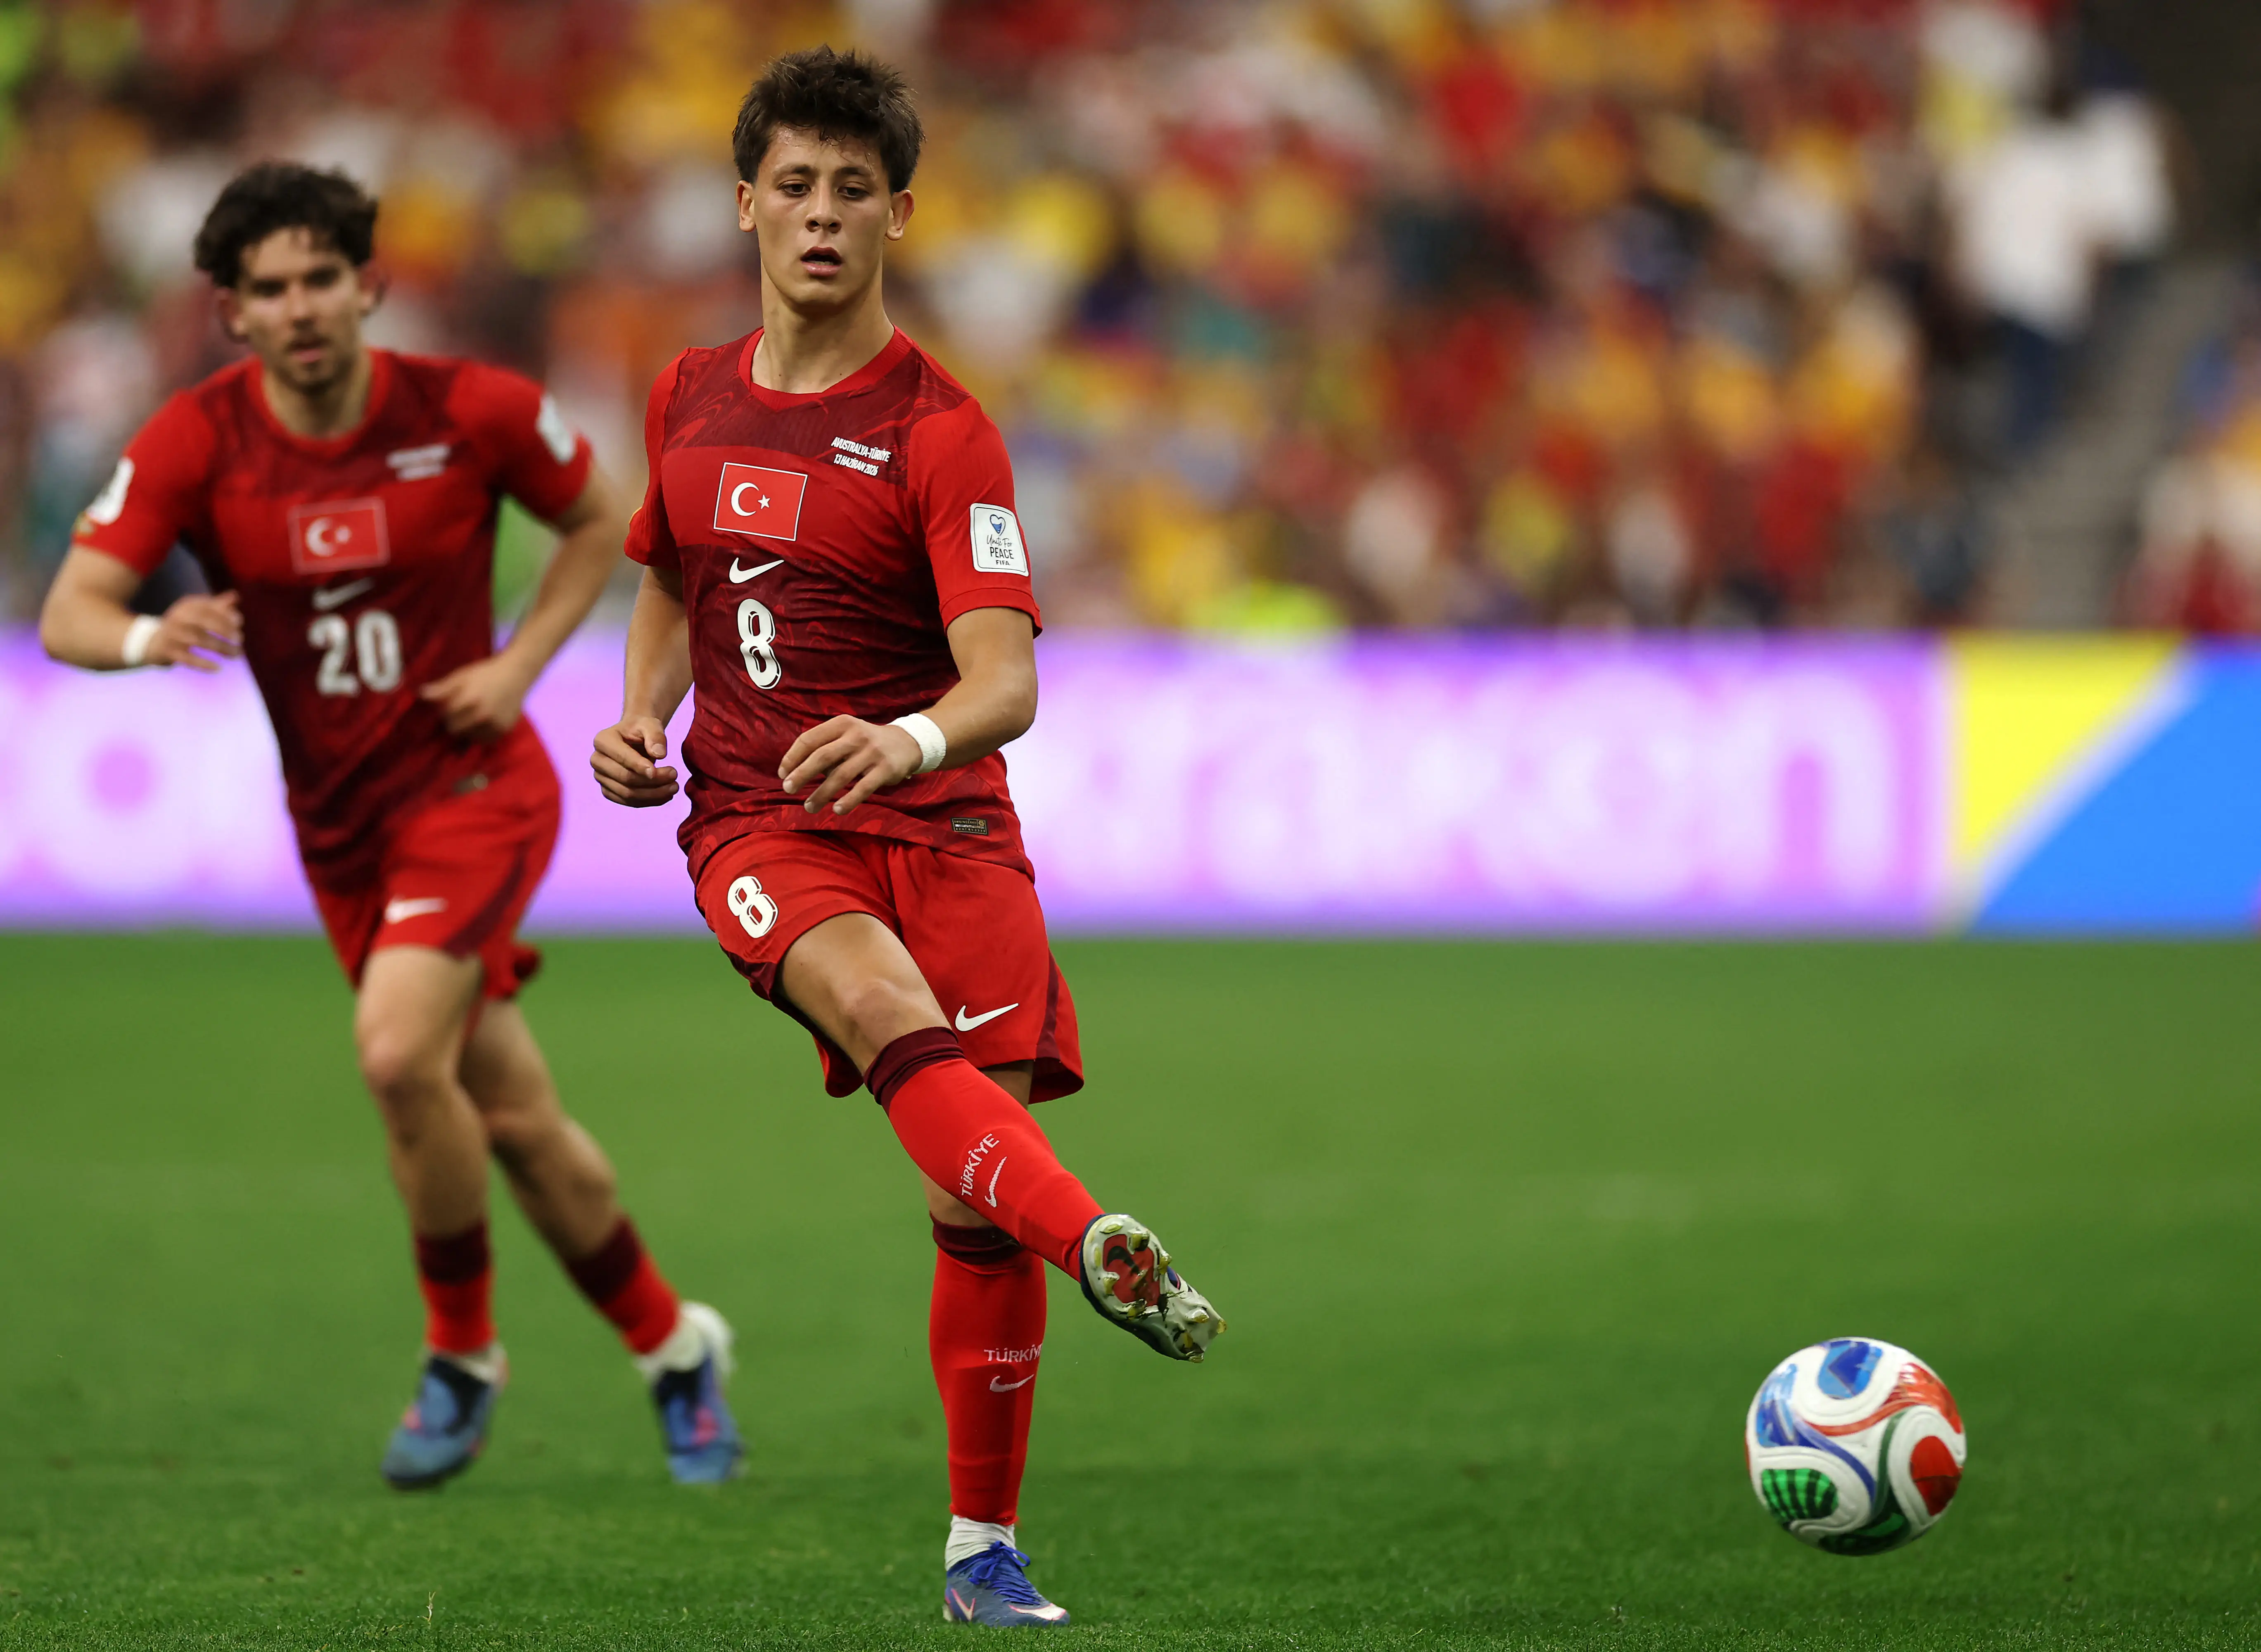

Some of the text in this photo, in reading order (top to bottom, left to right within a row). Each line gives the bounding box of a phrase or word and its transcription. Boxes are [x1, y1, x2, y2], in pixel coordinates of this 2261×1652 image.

[833, 453, 879, 476] 13 HAZİRAN 2026
[987, 534, 1012, 548] Unite For
[989, 547, 1014, 559] PEACE
[307, 610, 403, 697] 20
[738, 598, 781, 689] 8
[727, 876, 779, 939] 8
[959, 1133, 1000, 1196] TÜRKİYE
